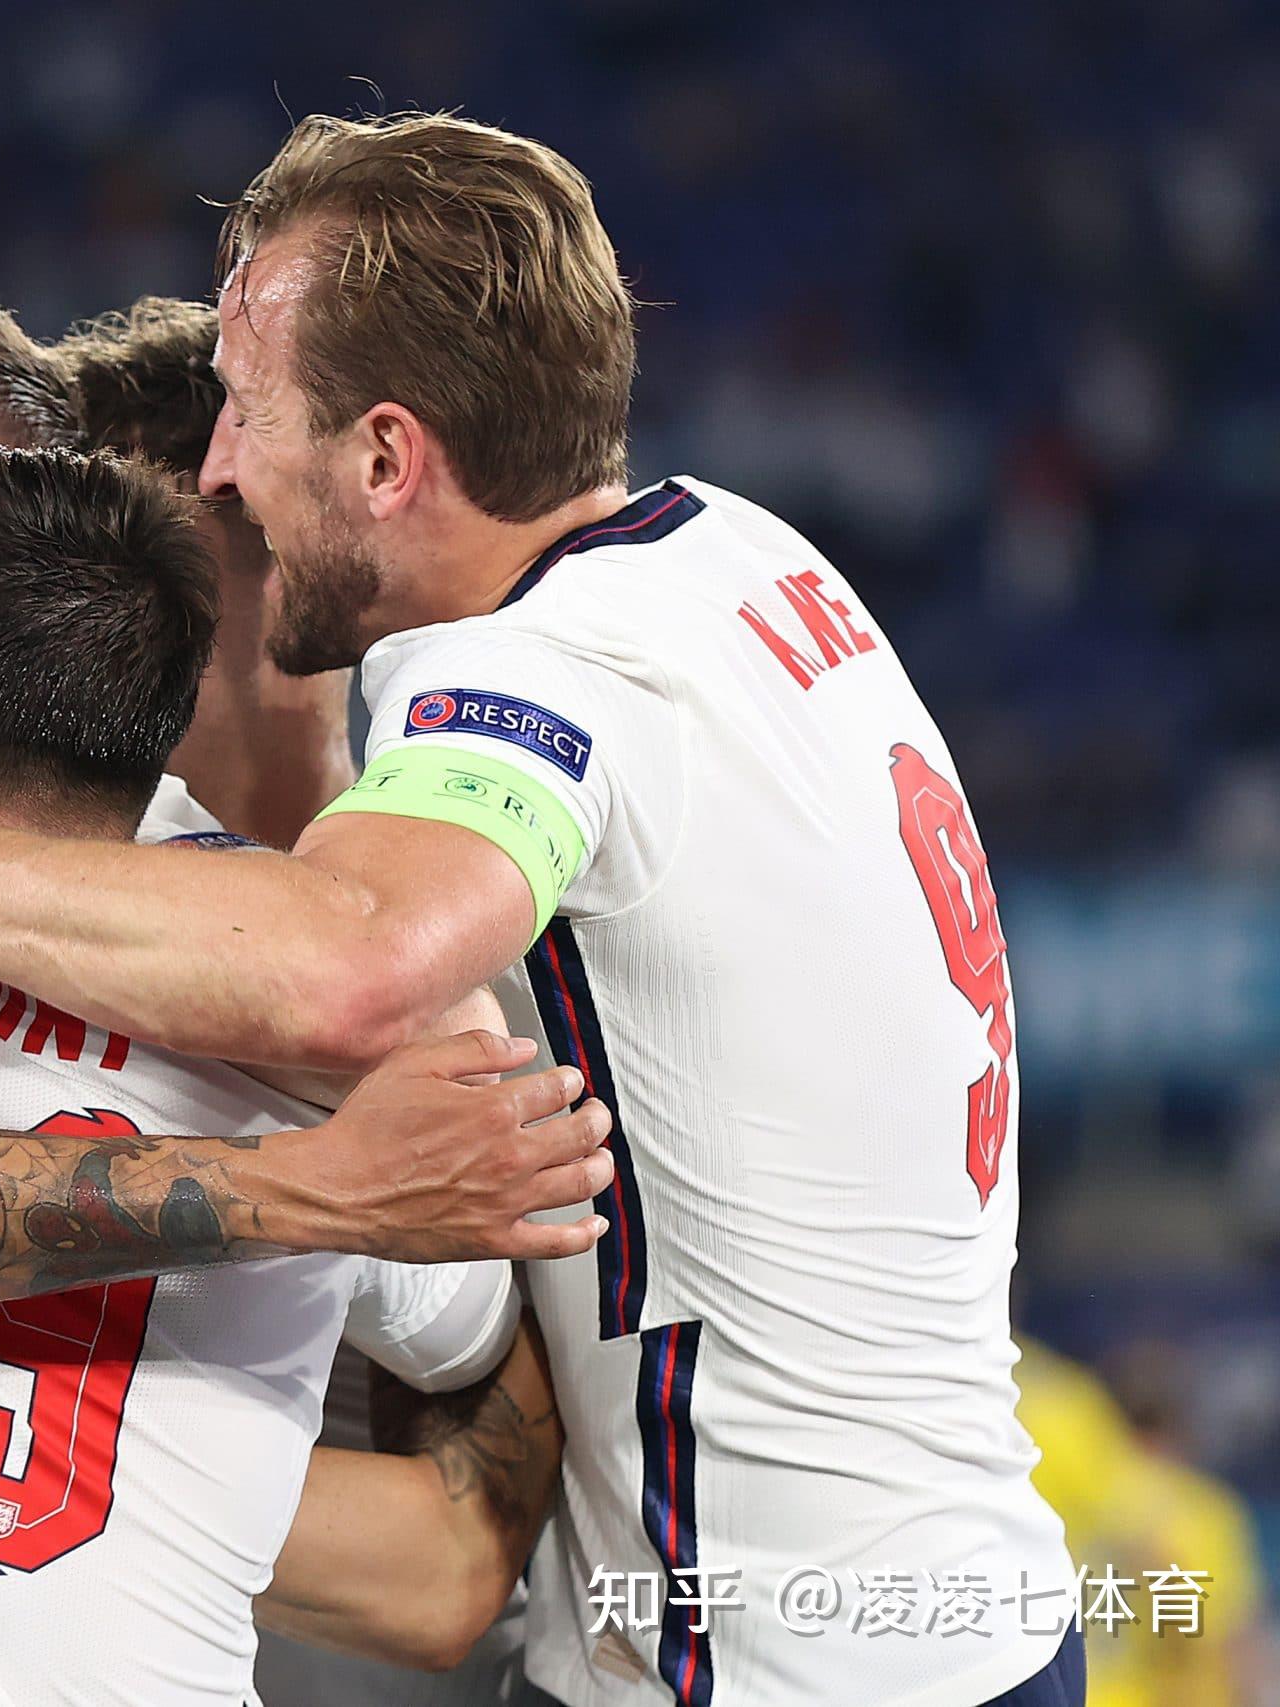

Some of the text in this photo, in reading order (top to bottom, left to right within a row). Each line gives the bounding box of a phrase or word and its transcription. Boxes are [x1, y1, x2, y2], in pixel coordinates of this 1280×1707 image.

[737, 570, 877, 691] KNE
[460, 701, 588, 764] RESPECT
[888, 742, 1009, 1212] 9
